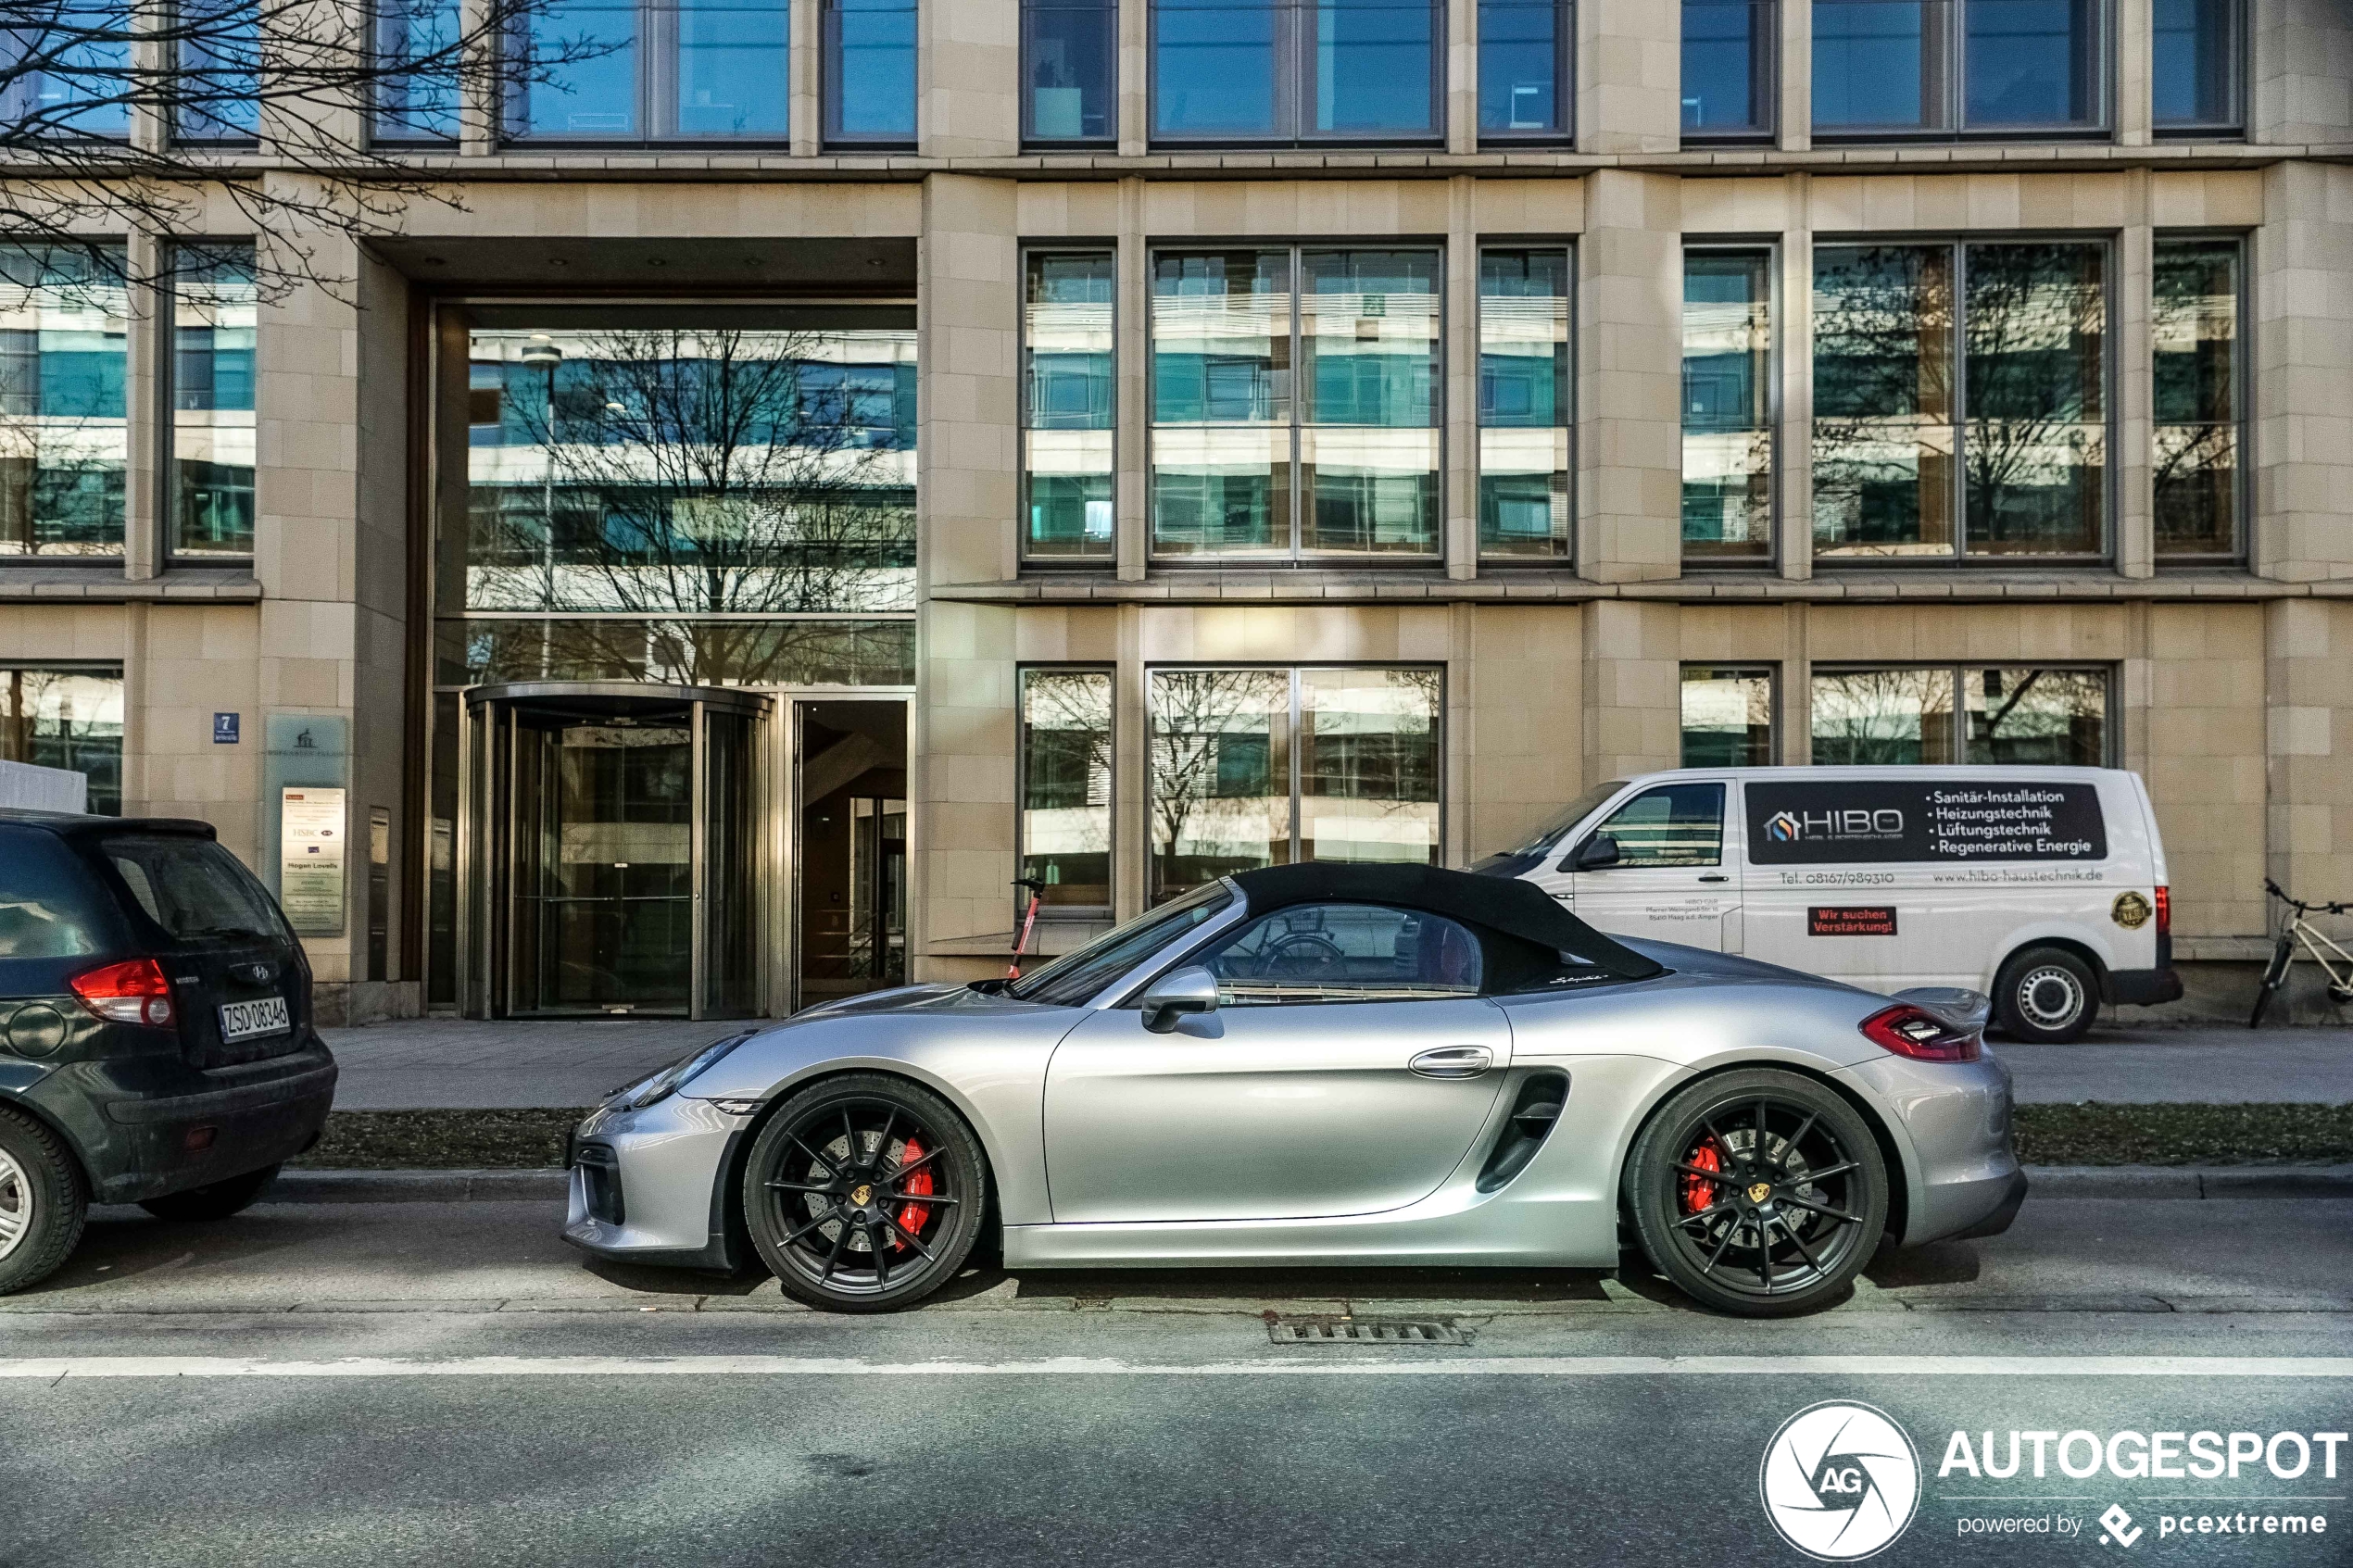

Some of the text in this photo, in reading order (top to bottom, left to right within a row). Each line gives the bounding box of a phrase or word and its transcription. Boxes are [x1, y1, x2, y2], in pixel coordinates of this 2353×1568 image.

[222, 716, 231, 730] 7
[1933, 789, 2065, 804] Sanitär-Installation
[1803, 809, 1905, 834] HIBO
[1936, 806, 2054, 822] Heizungstechnik
[1937, 822, 2052, 839] Lüftungstechnik
[1939, 838, 2092, 856] Regenerative Energie
[1780, 872, 1894, 885] Tel. 08167/989310
[1933, 868, 2103, 883] www.hibo-haustechnik.de
[1818, 909, 1887, 921] Wir suchen
[1813, 922, 1893, 934] Verstärkung!
[223, 999, 287, 1034] ZSD 08346
